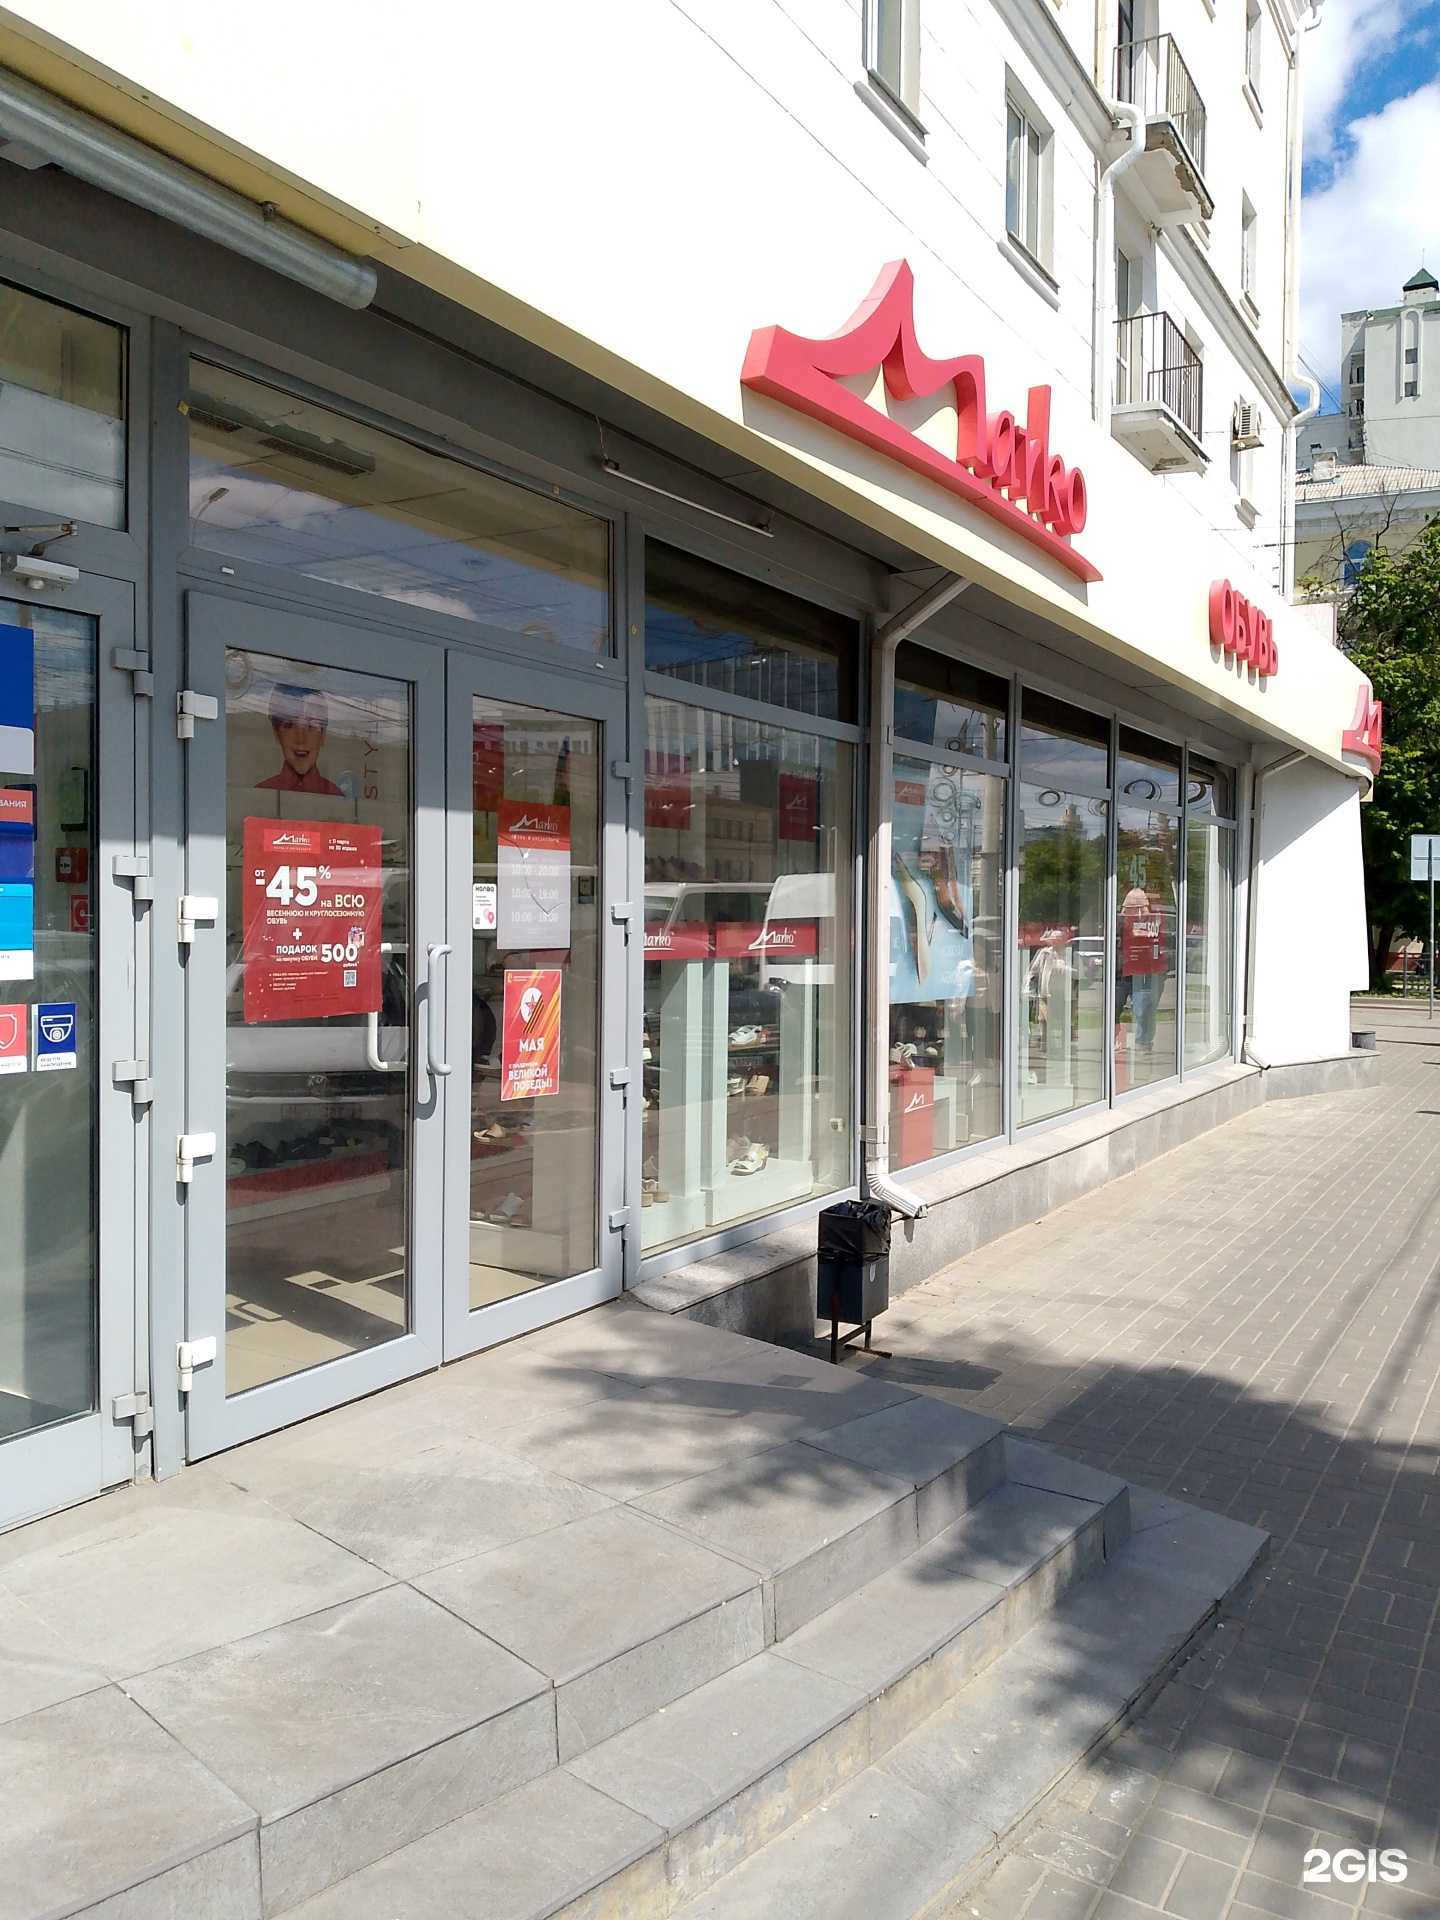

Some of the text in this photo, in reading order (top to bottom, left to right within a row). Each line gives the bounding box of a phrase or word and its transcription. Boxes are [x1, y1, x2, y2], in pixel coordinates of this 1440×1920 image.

[741, 258, 1103, 581] Marko
[1208, 579, 1278, 677] ОБУВЬ
[509, 814, 560, 835] Marko
[272, 833, 312, 846] Marko
[255, 869, 265, 877] от
[320, 894, 365, 908] на ВСЮ
[748, 928, 798, 950] Marko
[276, 943, 358, 963] ПОДАРОК 500
[520, 1037, 545, 1053] МАЯ
[508, 1064, 548, 1081] ВЕЛИКОЙ
